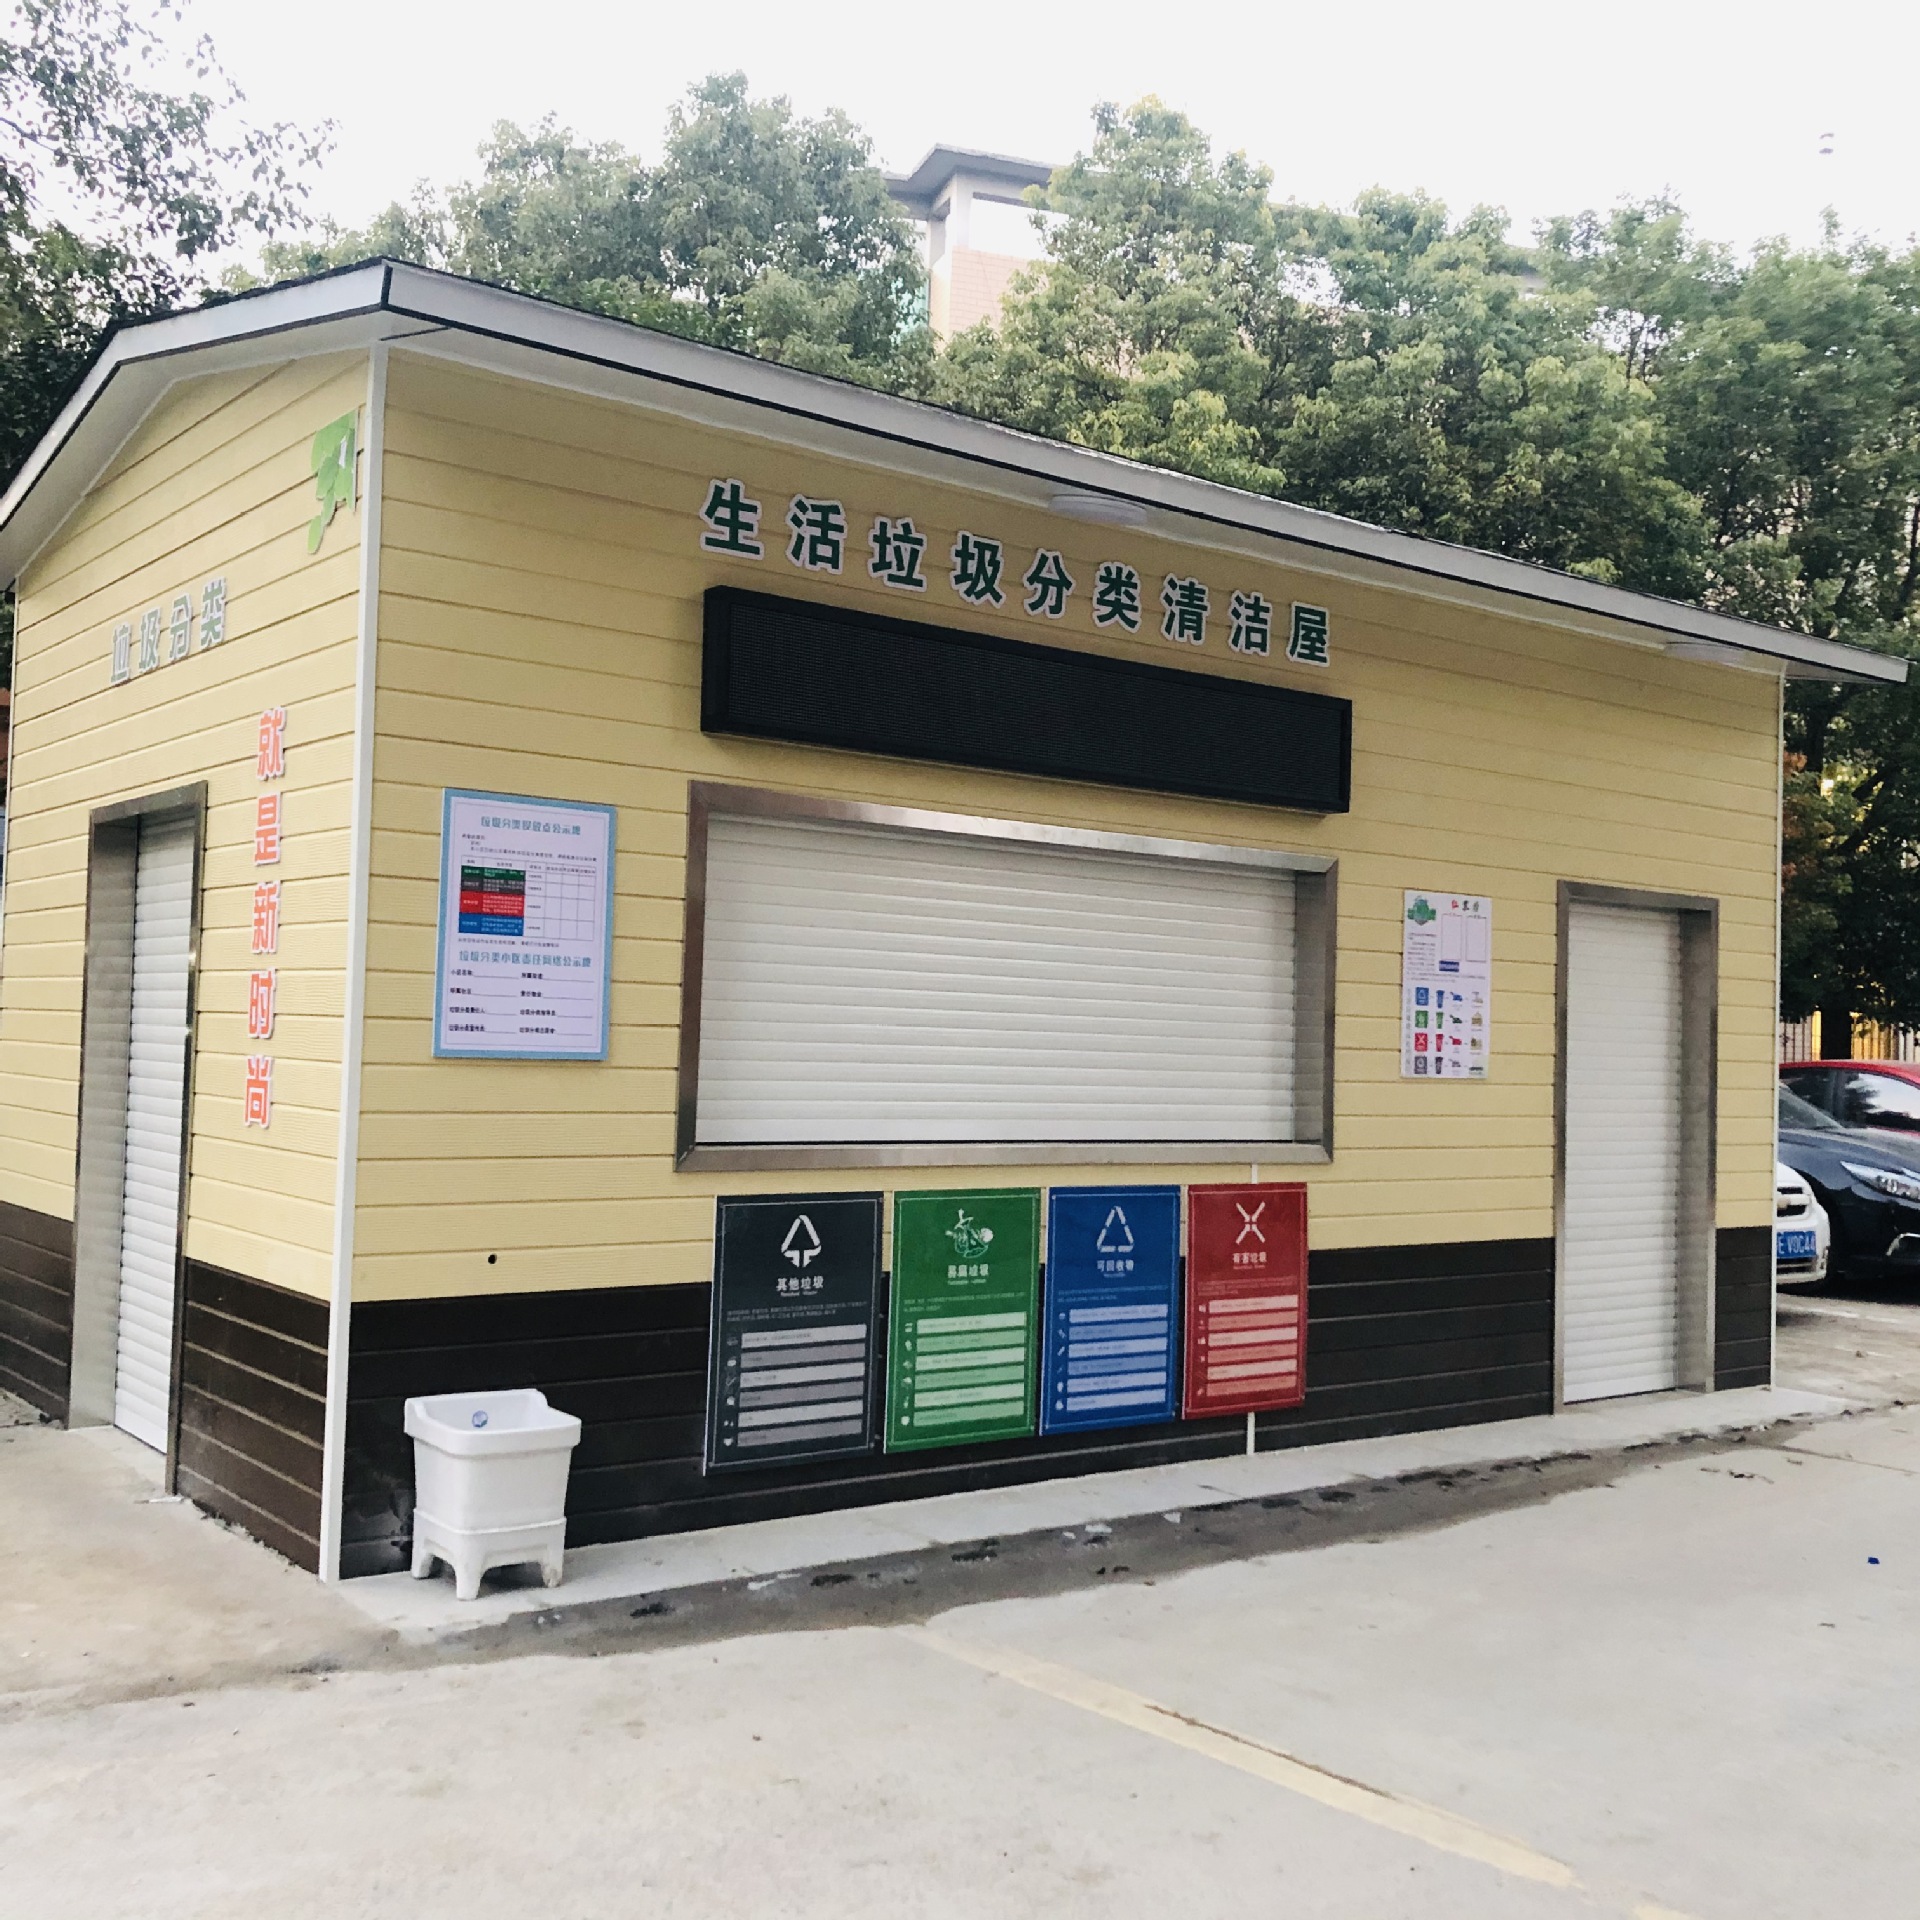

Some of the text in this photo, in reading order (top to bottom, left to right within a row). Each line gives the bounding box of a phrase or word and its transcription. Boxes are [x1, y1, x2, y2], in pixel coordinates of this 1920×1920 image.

[110, 576, 226, 684] 垃圾分类
[702, 479, 1331, 668] 生活垃圾分类清洁屋
[244, 706, 286, 1129] 就是新时尚
[775, 1275, 824, 1292] 其他垃圾
